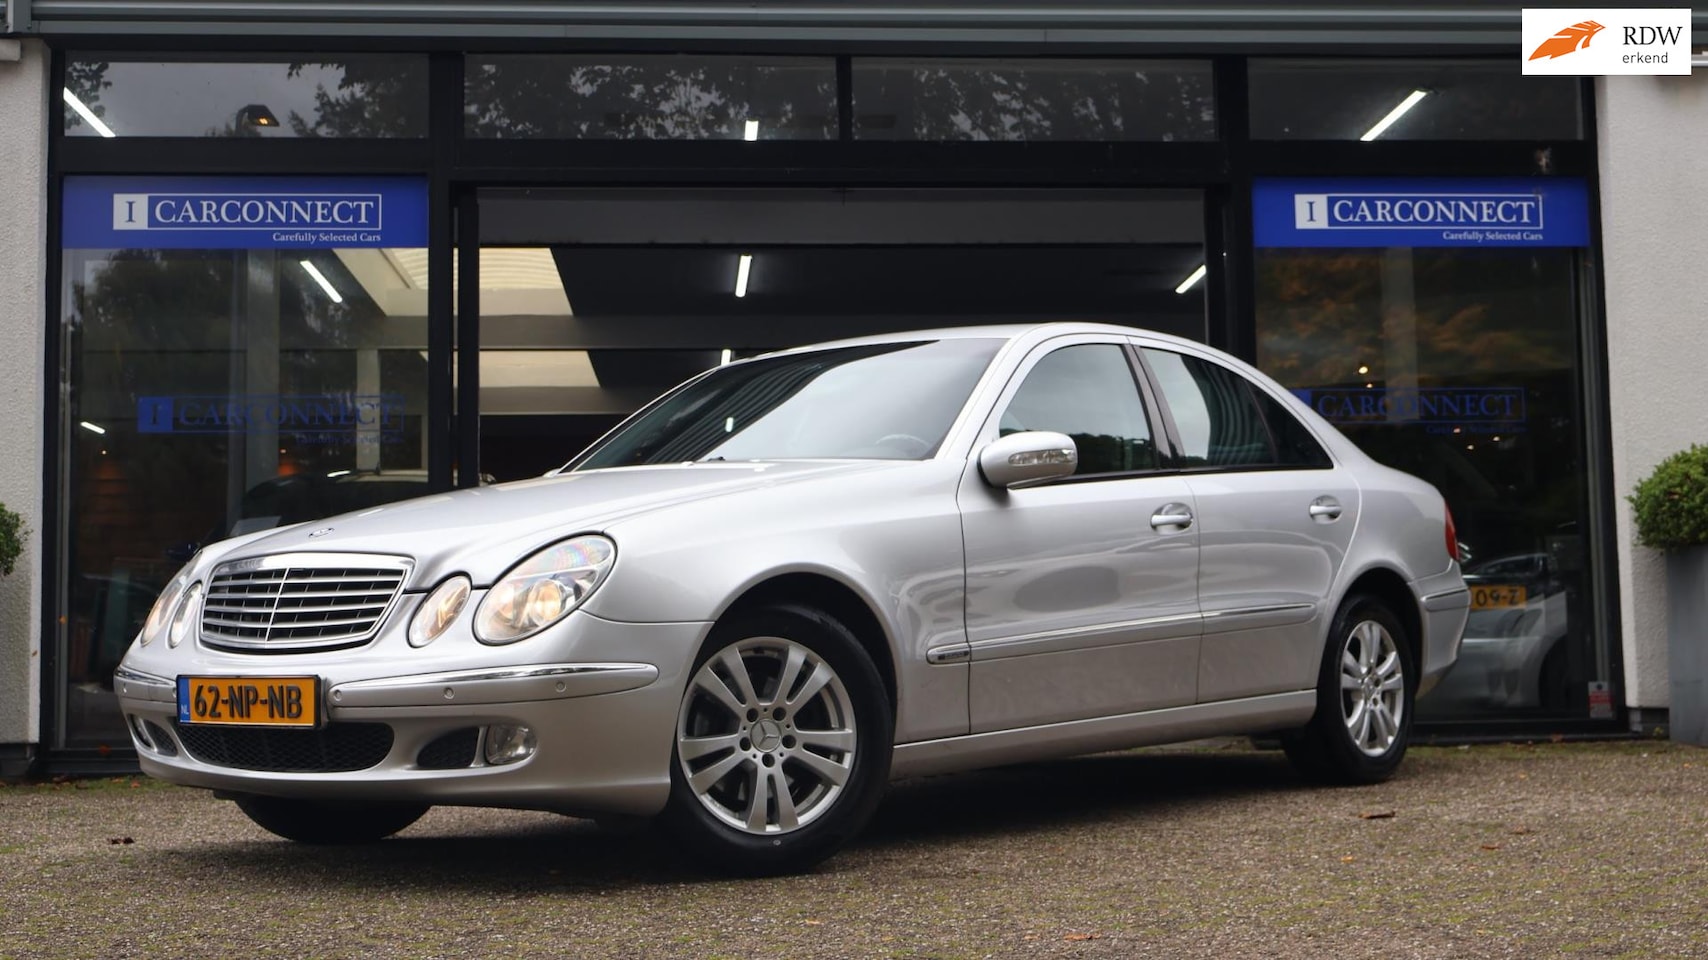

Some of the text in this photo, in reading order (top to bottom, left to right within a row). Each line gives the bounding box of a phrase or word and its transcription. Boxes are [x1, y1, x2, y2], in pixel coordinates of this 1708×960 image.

[125, 199, 374, 225] I CARCONNECT
[1306, 200, 1535, 223] I CARCONNECT
[272, 232, 381, 244] Carefully Selected Cars
[1442, 231, 1543, 242] Carefully Selected Cars
[178, 400, 393, 426] CARCONNECT
[1317, 393, 1518, 418] CARCONNECT
[180, 704, 189, 715] NL
[194, 684, 303, 719] 62-NP-NB
